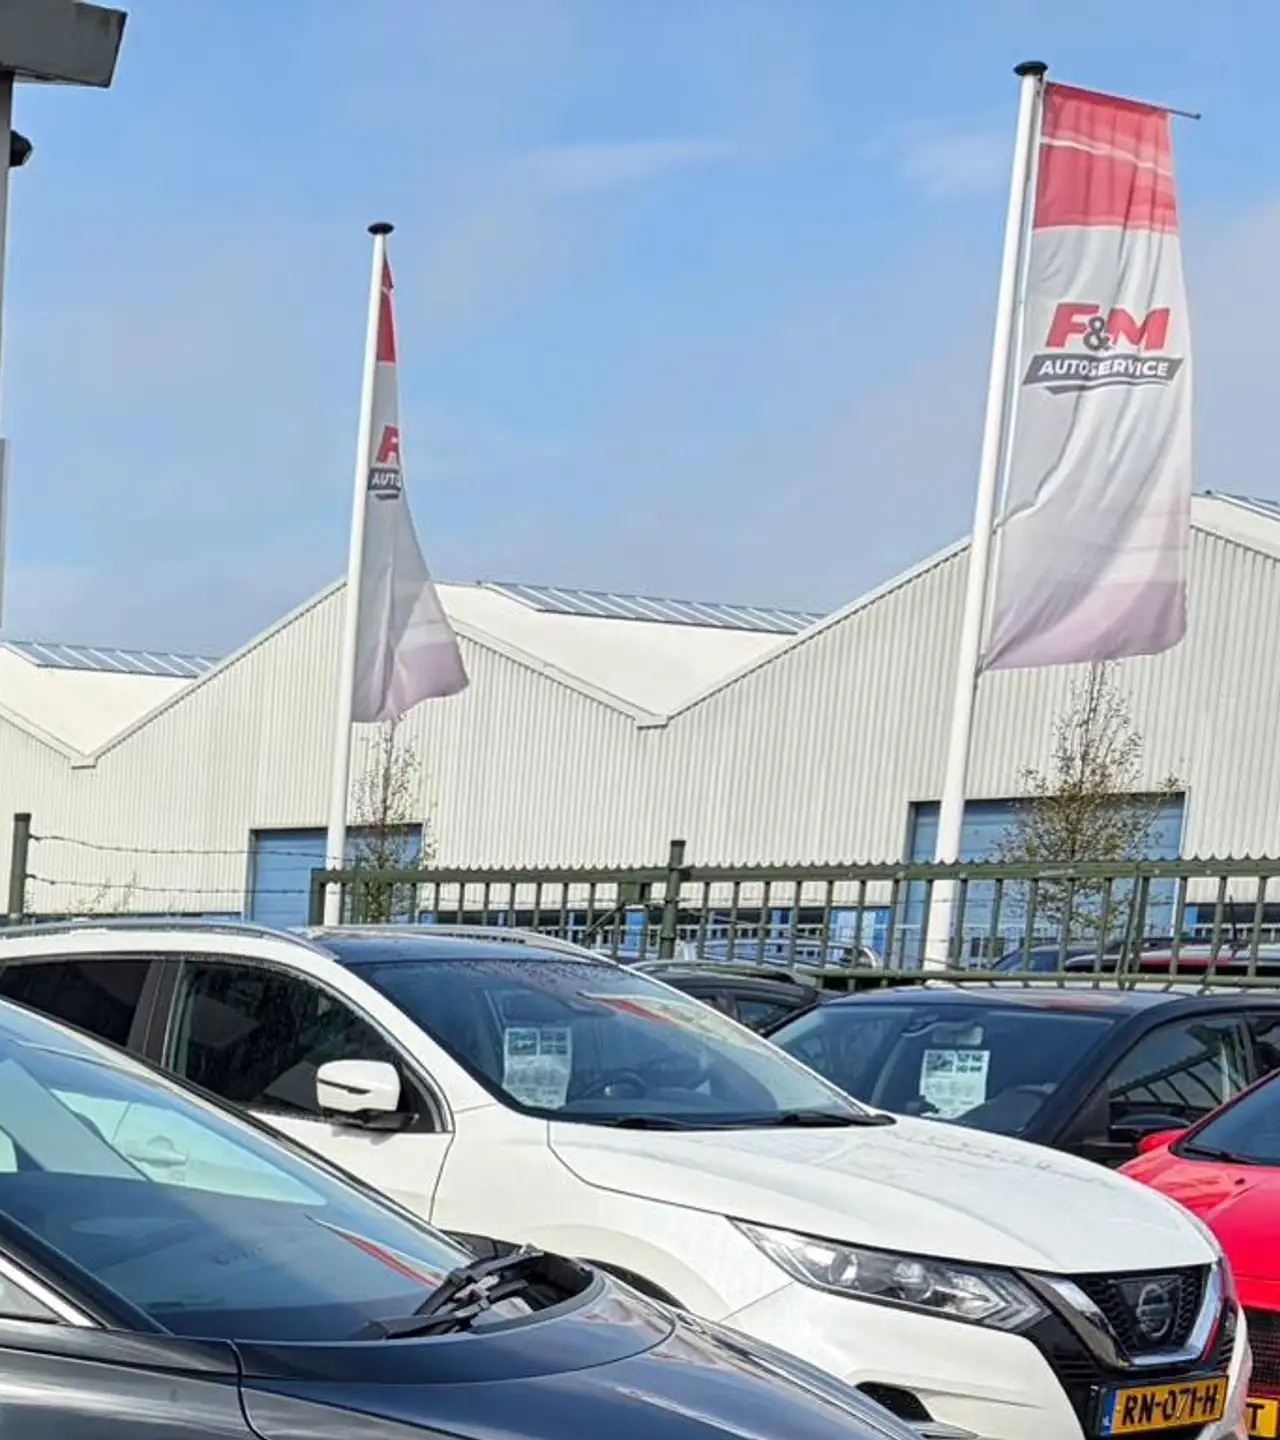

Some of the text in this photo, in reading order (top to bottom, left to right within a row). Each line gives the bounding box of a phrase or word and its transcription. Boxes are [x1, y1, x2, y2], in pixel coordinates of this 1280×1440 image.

[1045, 302, 1171, 351] F&M
[1039, 358, 1169, 377] AUTOSERVICE
[1121, 1383, 1219, 1426] RN-071-H
